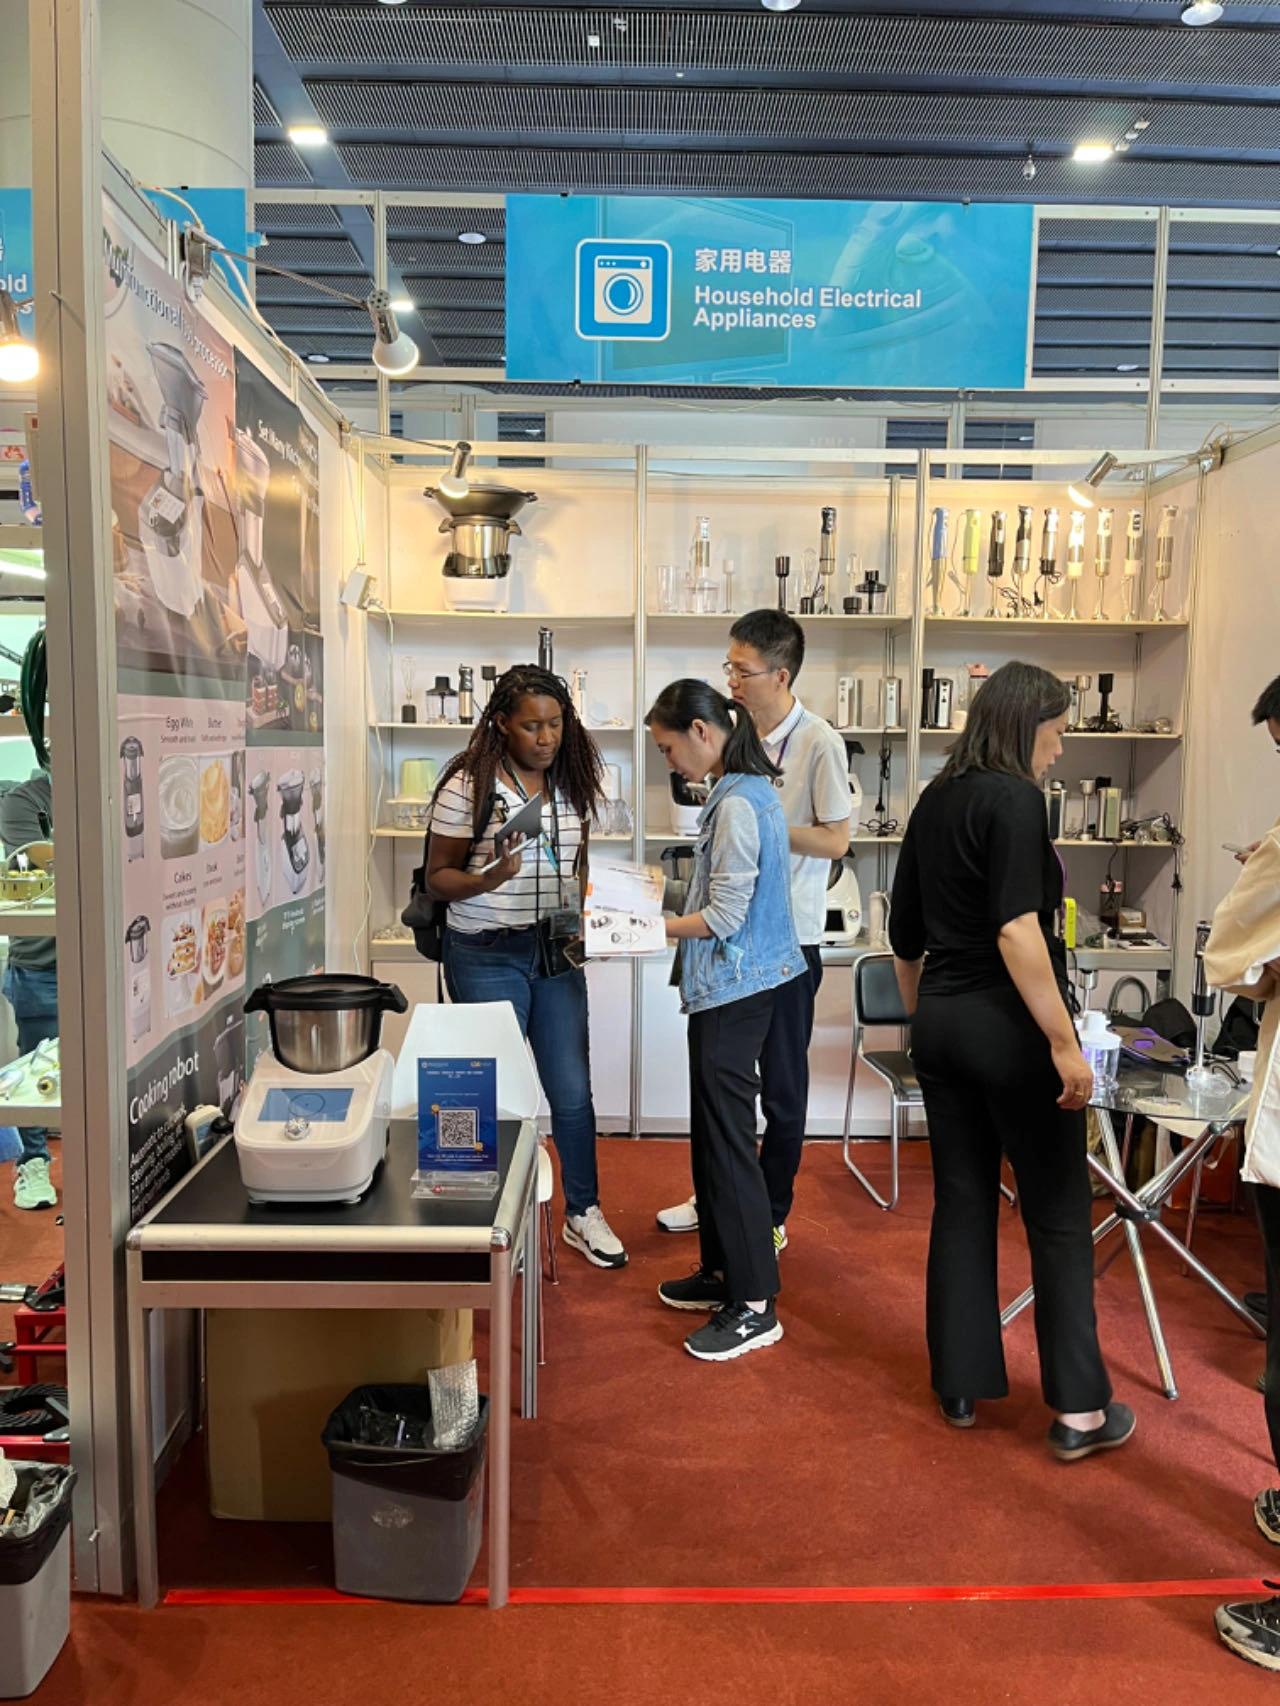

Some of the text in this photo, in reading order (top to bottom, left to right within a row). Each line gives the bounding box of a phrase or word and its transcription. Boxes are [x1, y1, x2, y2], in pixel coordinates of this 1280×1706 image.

[695, 249, 791, 273] 家用电器
[694, 286, 922, 308] Household Electrical
[693, 308, 816, 331] Appliances
[130, 1075, 168, 1124] Cooking
